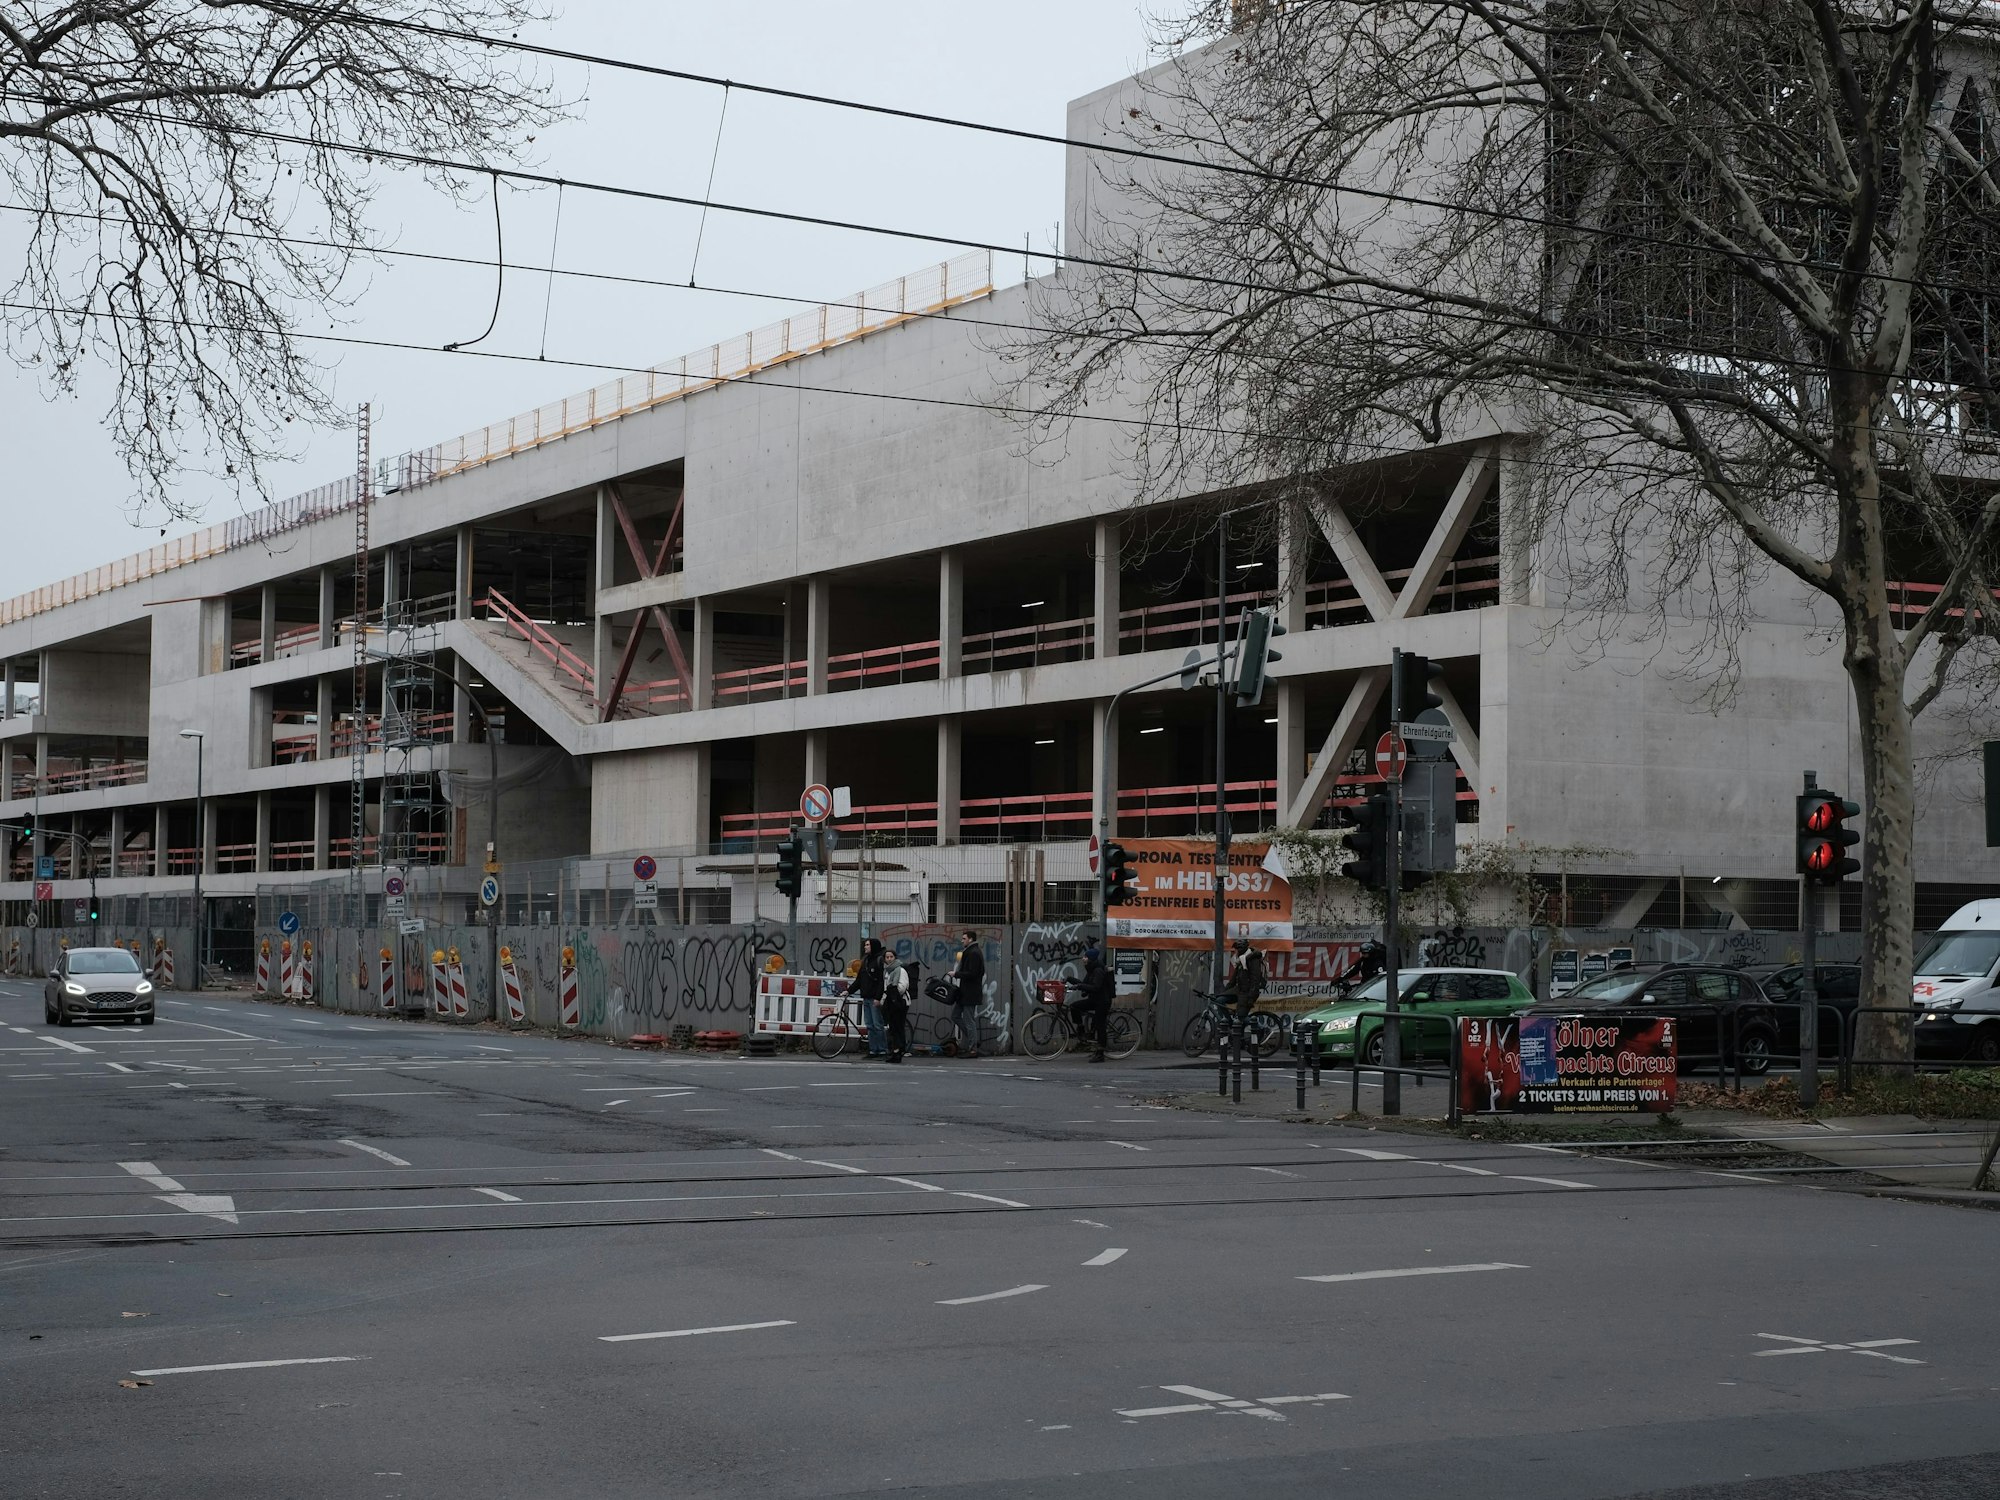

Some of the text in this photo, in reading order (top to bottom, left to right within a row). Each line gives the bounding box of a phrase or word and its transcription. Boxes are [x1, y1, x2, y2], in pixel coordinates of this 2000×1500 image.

[1403, 725, 1454, 739] Ehrenfeldgürtel
[1155, 870, 1274, 893] IM HELOS37
[1119, 895, 1281, 911] OSTENFREIE BÜGERTESTS
[1471, 1021, 1479, 1035] 3
[1663, 1022, 1671, 1035] 2
[1661, 1035, 1673, 1043] JAN
[1617, 1051, 1676, 1075] Circus
[1560, 1077, 1595, 1087] Verkauf:
[1598, 1077, 1612, 1087] die
[1613, 1077, 1665, 1088] Partnertage!
[1519, 1089, 1669, 1102] 2 TICKETS ZUM PREIS VON 1.
